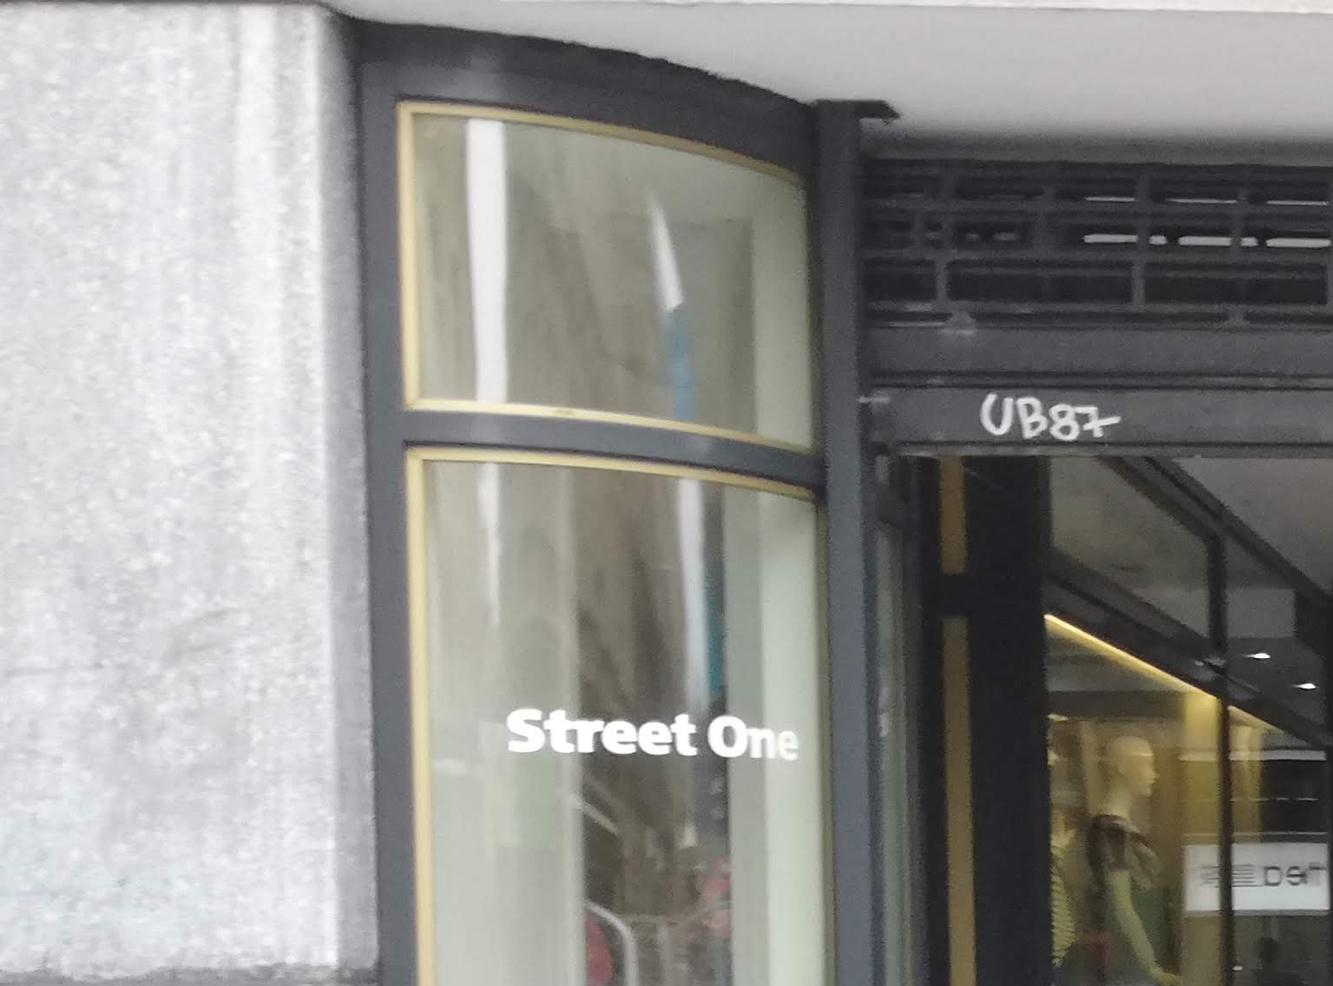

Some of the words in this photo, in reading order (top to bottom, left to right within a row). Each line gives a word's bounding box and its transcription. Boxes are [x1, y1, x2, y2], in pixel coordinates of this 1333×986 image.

[980, 393, 1121, 441] UB87
[506, 708, 698, 756] Street
[707, 715, 799, 761] One
